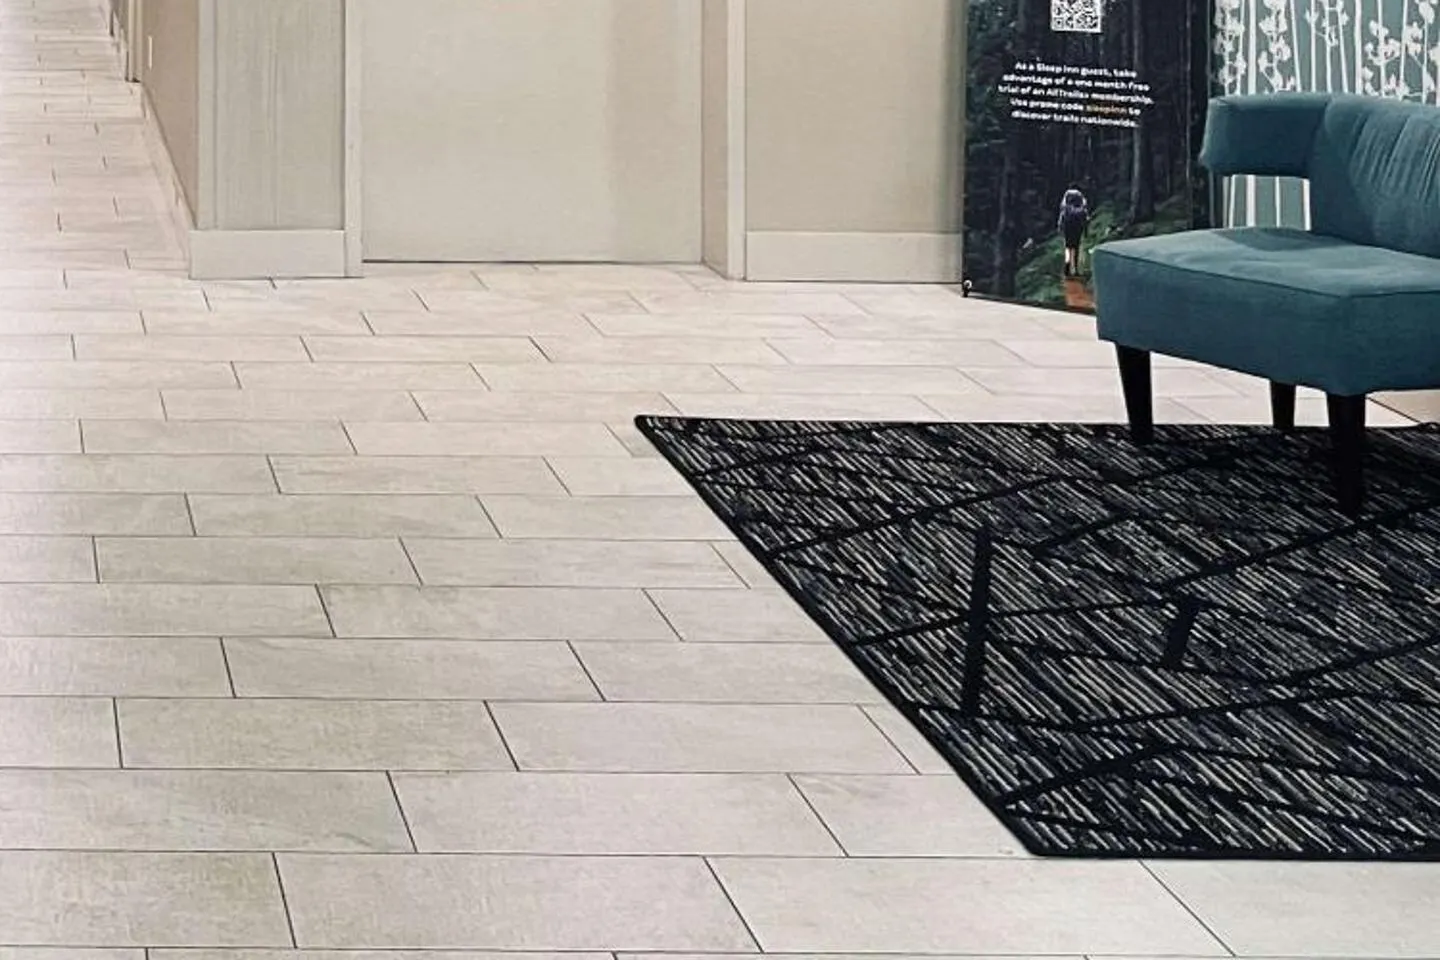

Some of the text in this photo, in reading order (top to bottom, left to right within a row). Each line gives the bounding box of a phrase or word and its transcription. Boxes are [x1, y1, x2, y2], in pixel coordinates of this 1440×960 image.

[1015, 61, 1027, 71] As
[1036, 62, 1063, 74] Sleep
[1063, 64, 1080, 73] Inn
[1081, 66, 1113, 77] guest,
[1113, 69, 1138, 78] take
[1002, 73, 1053, 86] advantage
[1054, 76, 1066, 85] of
[1094, 79, 1128, 89] month
[1128, 81, 1150, 91] free
[997, 84, 1020, 93] trial
[1020, 85, 1032, 95] of
[1032, 88, 1045, 96] an
[1010, 98, 1028, 107] Use
[1029, 99, 1059, 110] promo
[1061, 101, 1084, 111] code
[1011, 109, 1051, 120] discover
[1053, 112, 1079, 123] trails
